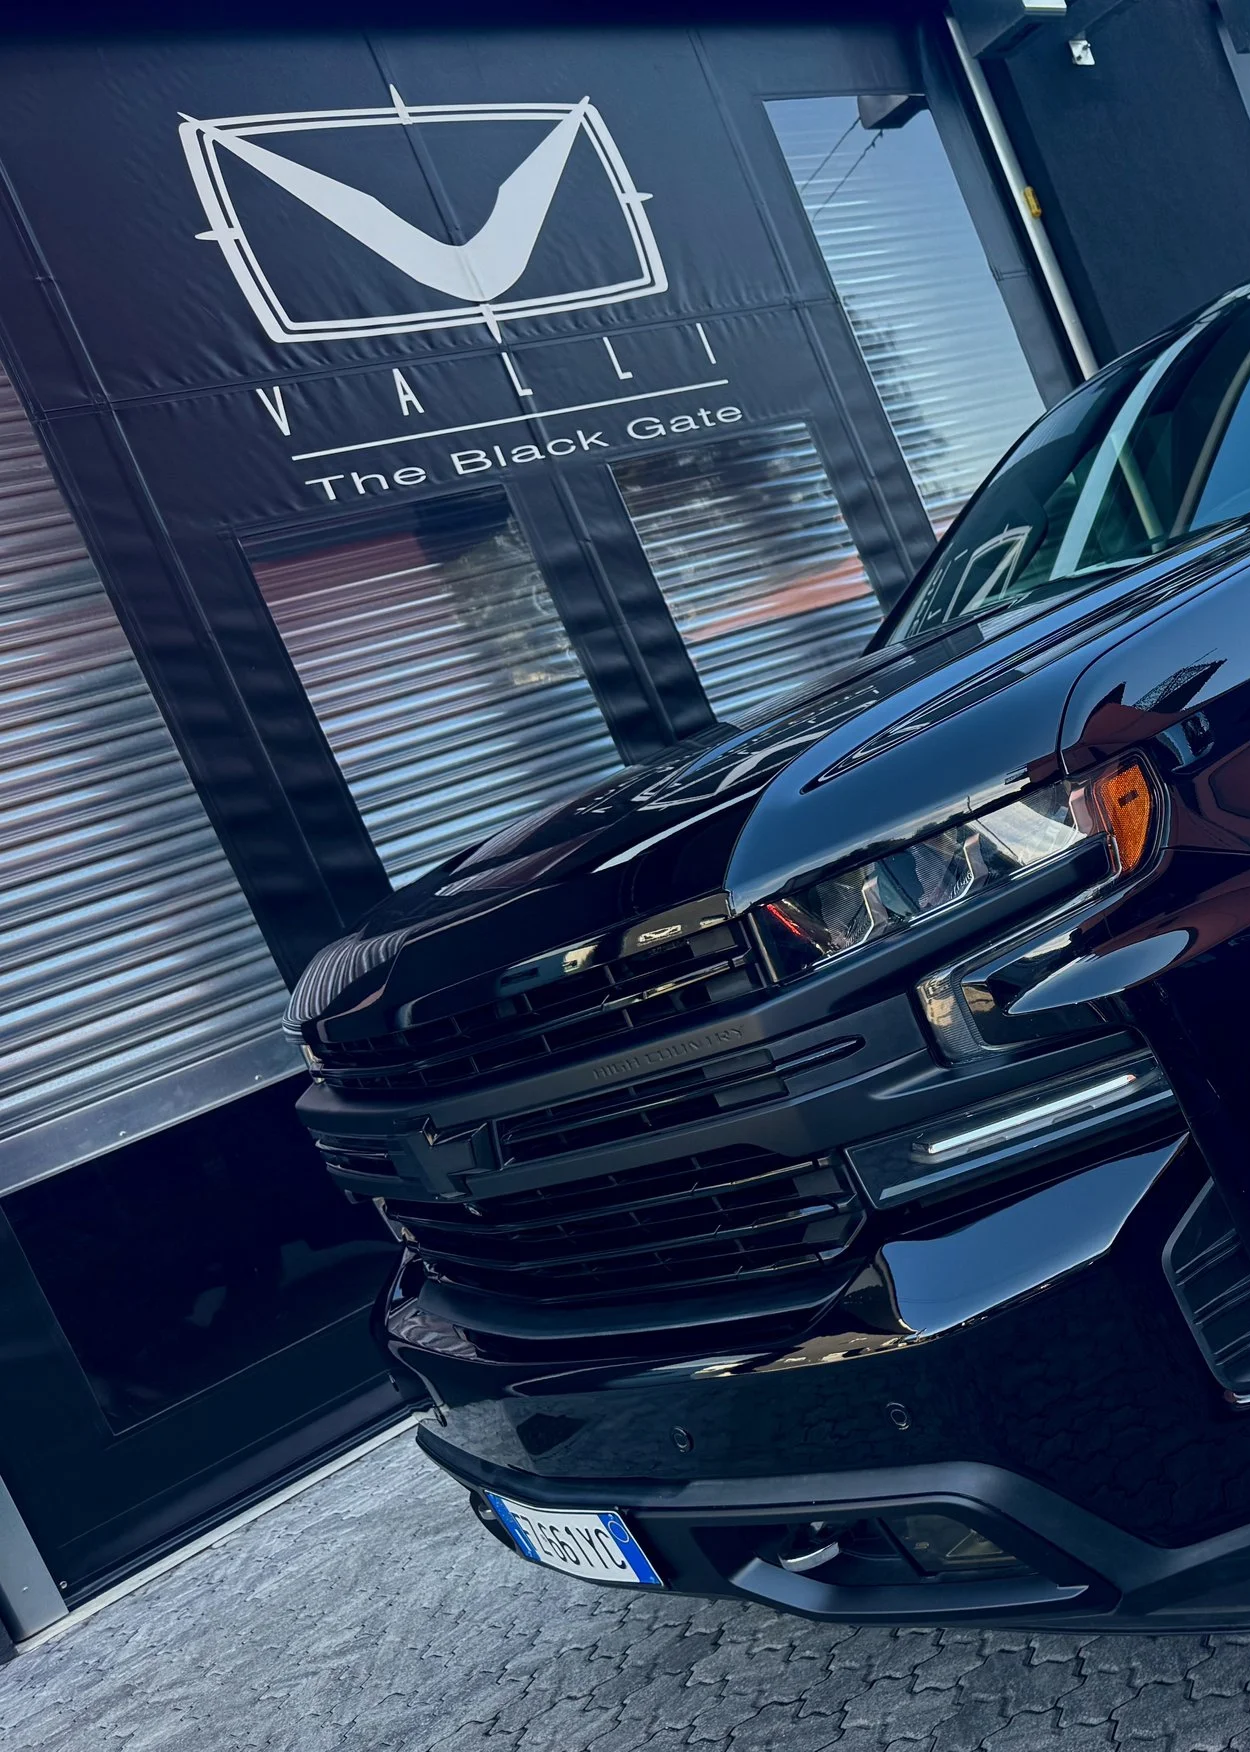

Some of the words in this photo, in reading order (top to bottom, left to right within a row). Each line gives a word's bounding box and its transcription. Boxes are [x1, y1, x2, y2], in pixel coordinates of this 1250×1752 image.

[255, 322, 717, 437] VALLI
[304, 465, 428, 501] The
[450, 429, 610, 476] Black
[627, 405, 744, 441] Gate
[592, 1056, 641, 1080] HIGH
